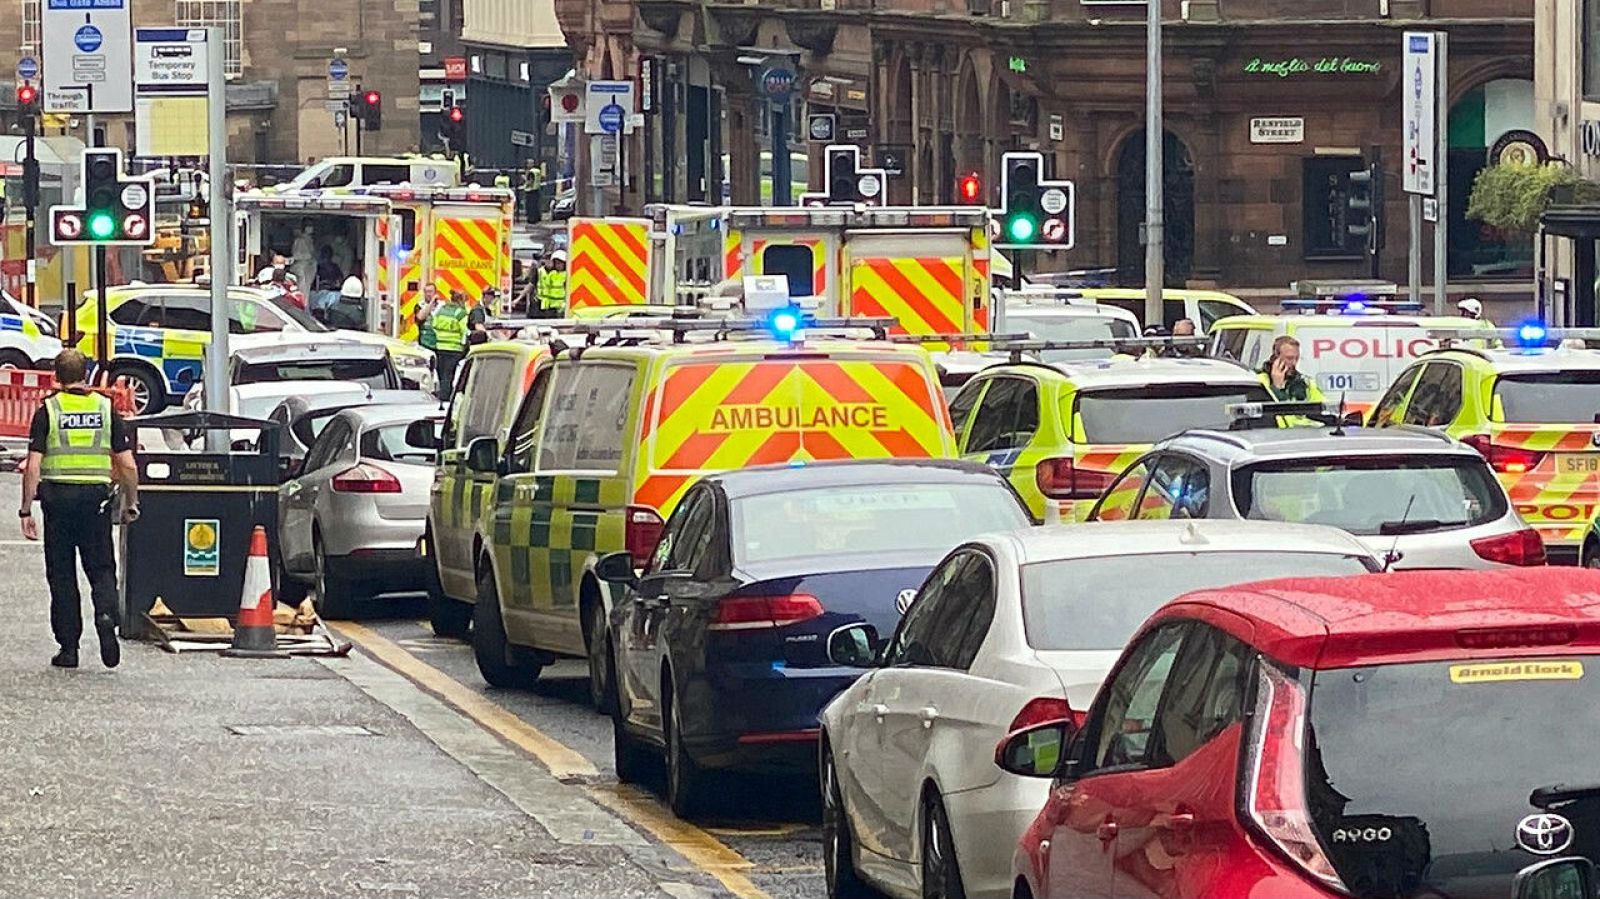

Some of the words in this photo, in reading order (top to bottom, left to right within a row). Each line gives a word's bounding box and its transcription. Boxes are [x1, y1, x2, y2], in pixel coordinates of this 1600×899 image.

[149, 61, 196, 71] Temporary
[1313, 58, 1338, 72] del
[152, 72, 169, 80] Bus
[171, 71, 193, 81] Stop
[47, 93, 83, 101] Through
[51, 101, 79, 109] traffic
[1253, 119, 1302, 128] RENFIELD
[1312, 338, 1459, 358] POLIC
[1328, 375, 1353, 389] 101
[60, 414, 101, 428] POLICE
[711, 405, 889, 430] AMBULANCE
[1566, 457, 1598, 471] SF18
[1458, 665, 1520, 677] Arnold
[1523, 664, 1573, 675] Clark
[1332, 826, 1392, 843] AYGO
